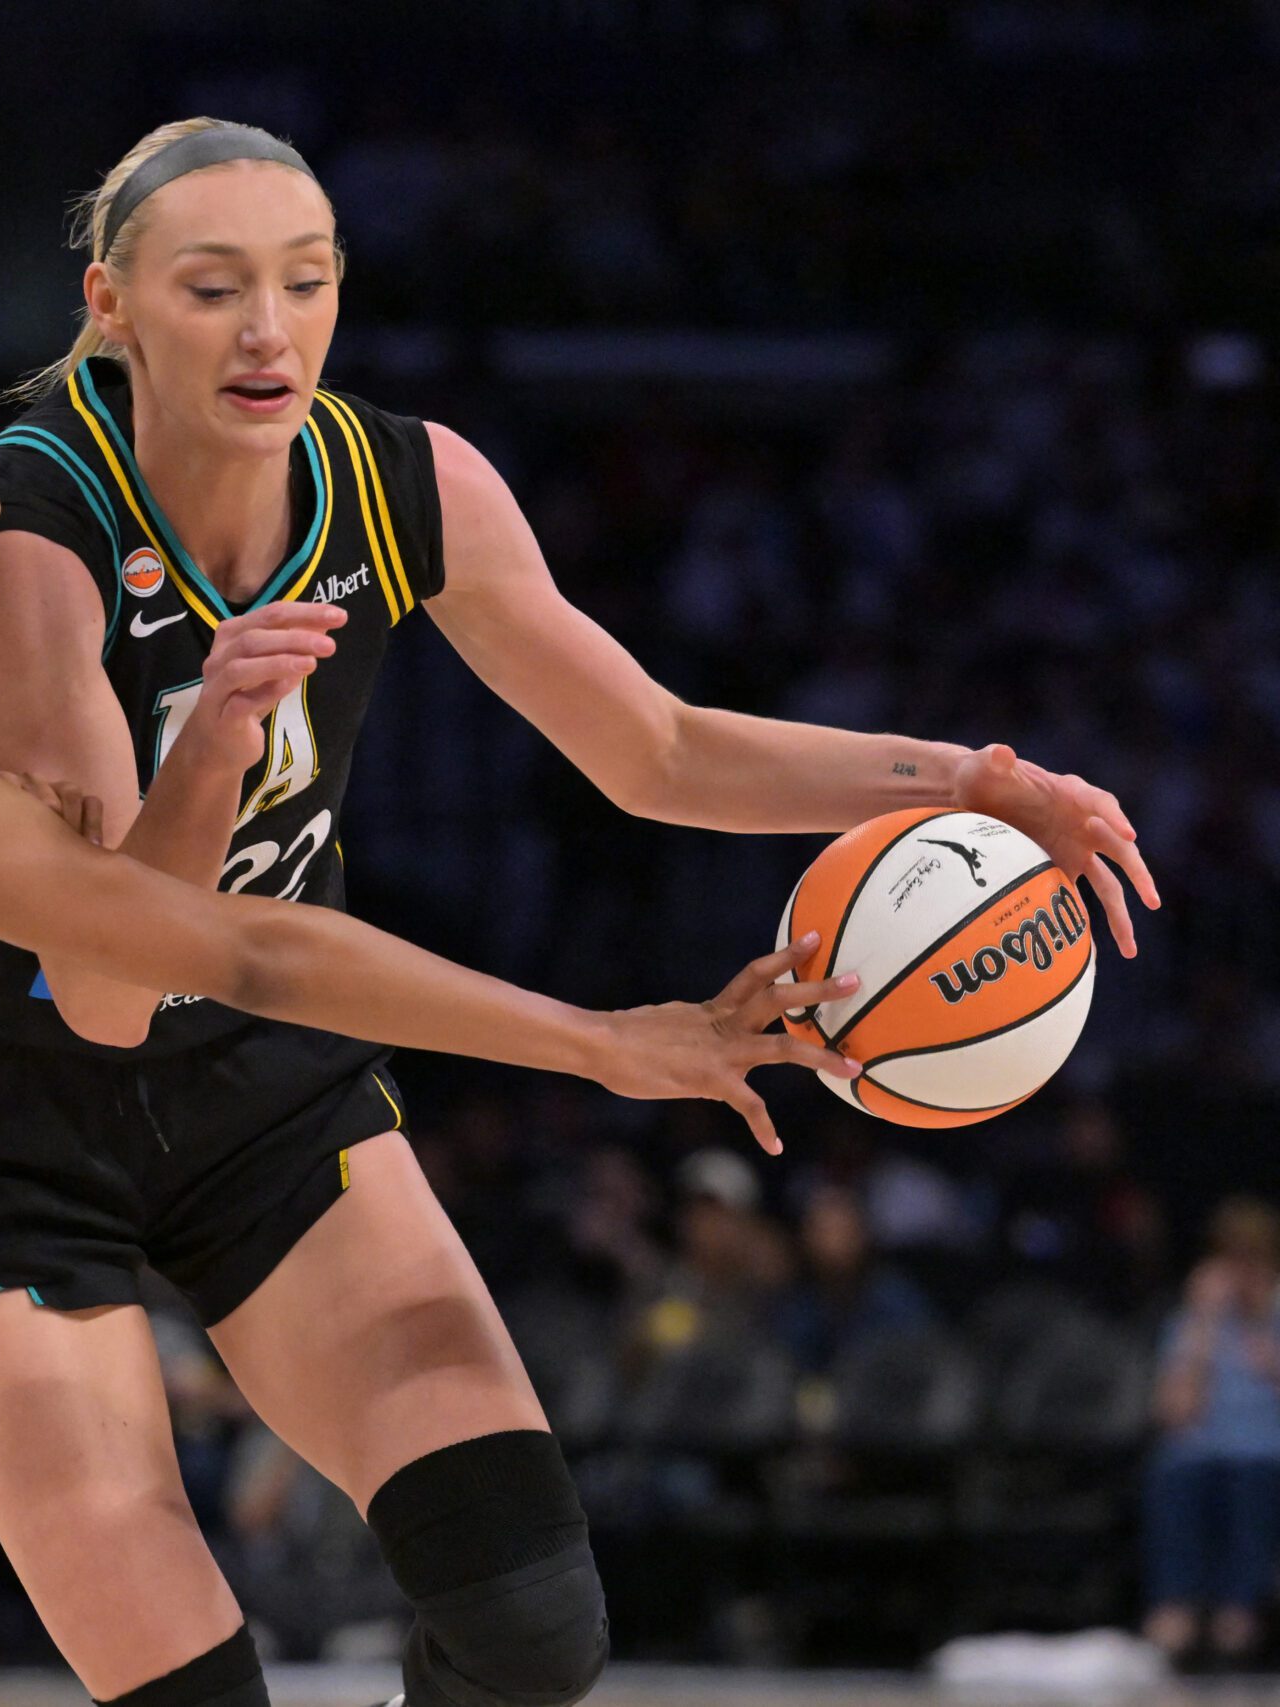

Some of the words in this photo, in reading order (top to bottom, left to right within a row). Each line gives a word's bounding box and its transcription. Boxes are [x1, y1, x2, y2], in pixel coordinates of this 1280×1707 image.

[312, 563, 370, 604] Albert
[1013, 896, 1031, 912] EVO
[993, 911, 1013, 927] NXT
[928, 884, 1087, 1005] Wilson
